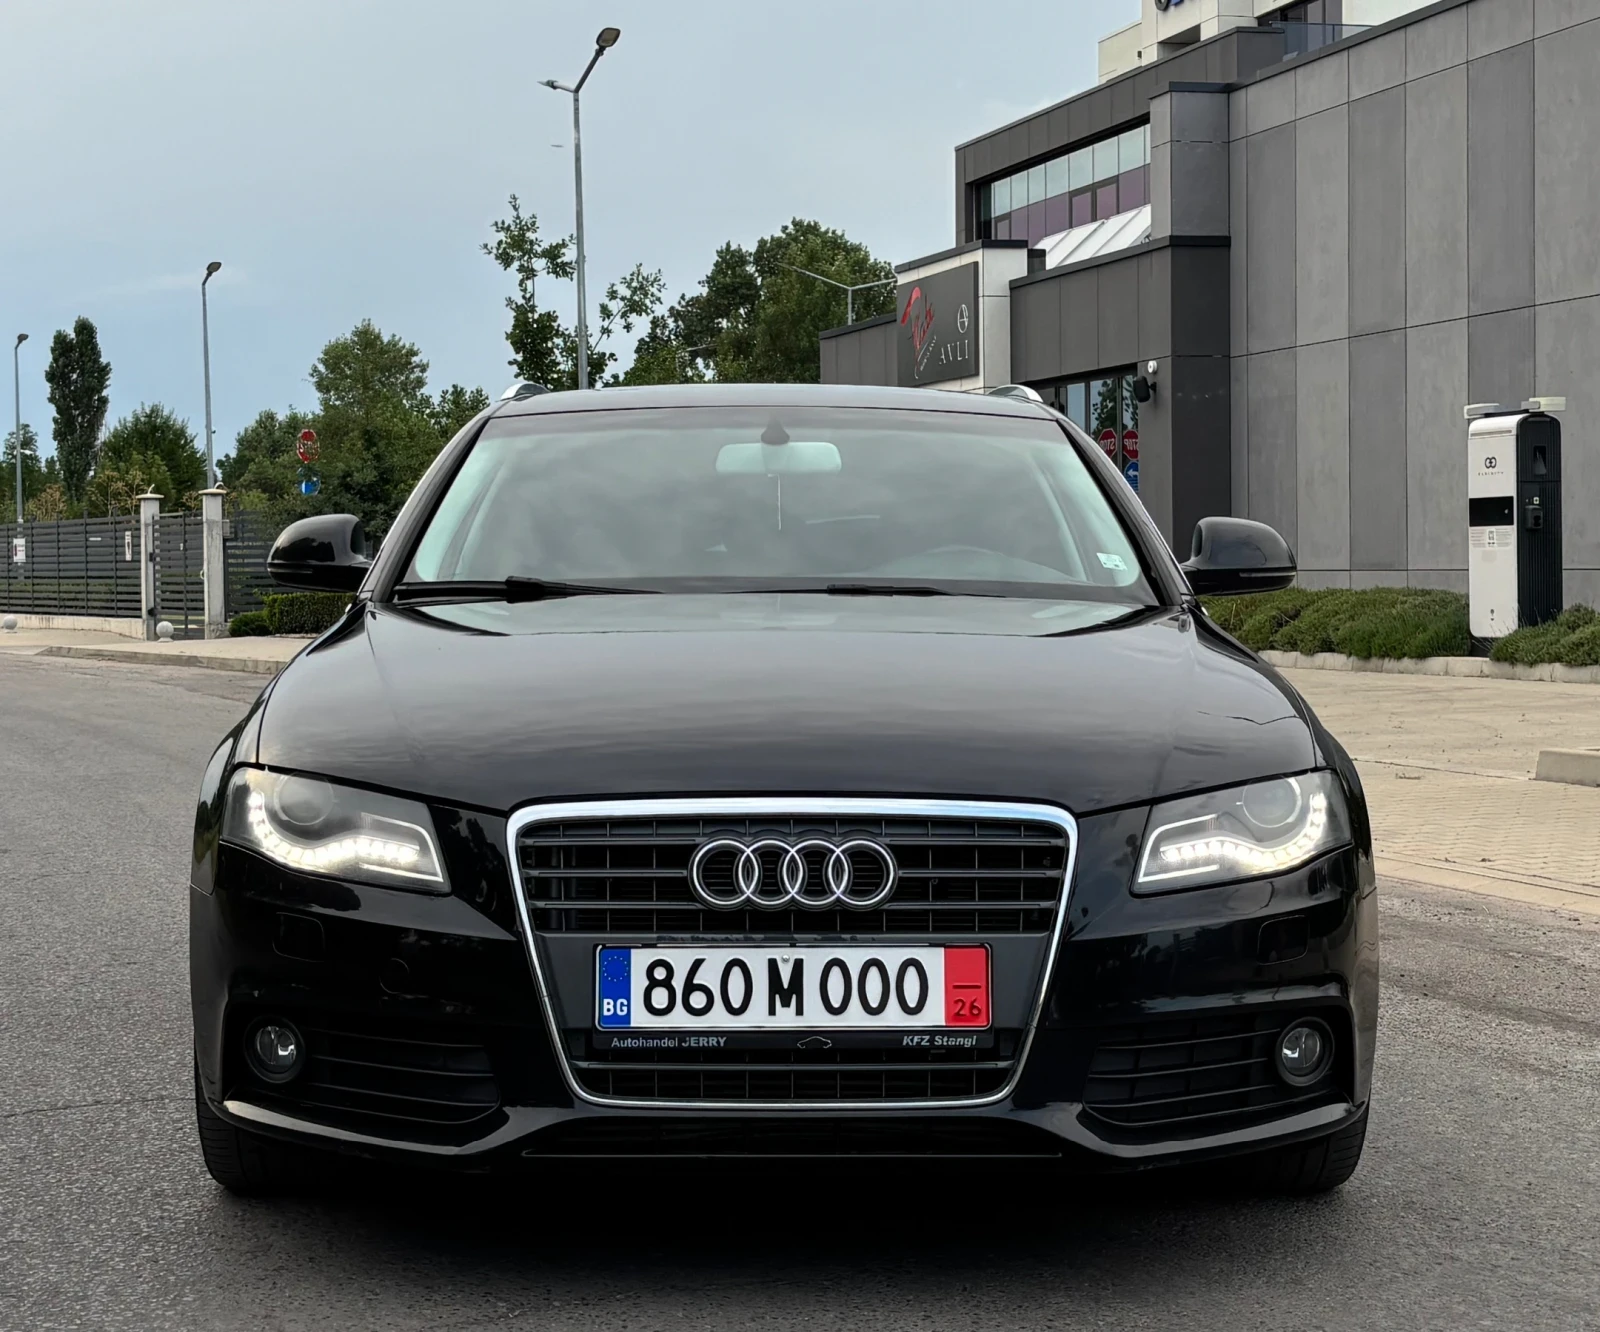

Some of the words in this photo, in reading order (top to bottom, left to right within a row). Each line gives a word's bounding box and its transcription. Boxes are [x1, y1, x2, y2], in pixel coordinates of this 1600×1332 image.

[643, 957, 753, 1017] 860
[768, 957, 804, 1017] M
[819, 957, 929, 1017] 000
[603, 998, 629, 1016] BG
[953, 997, 982, 1017] 26
[611, 1037, 678, 1048] Autohandel
[682, 1036, 727, 1047] JERRY
[902, 1035, 930, 1046] KFZ
[934, 1035, 977, 1048] Stangl
